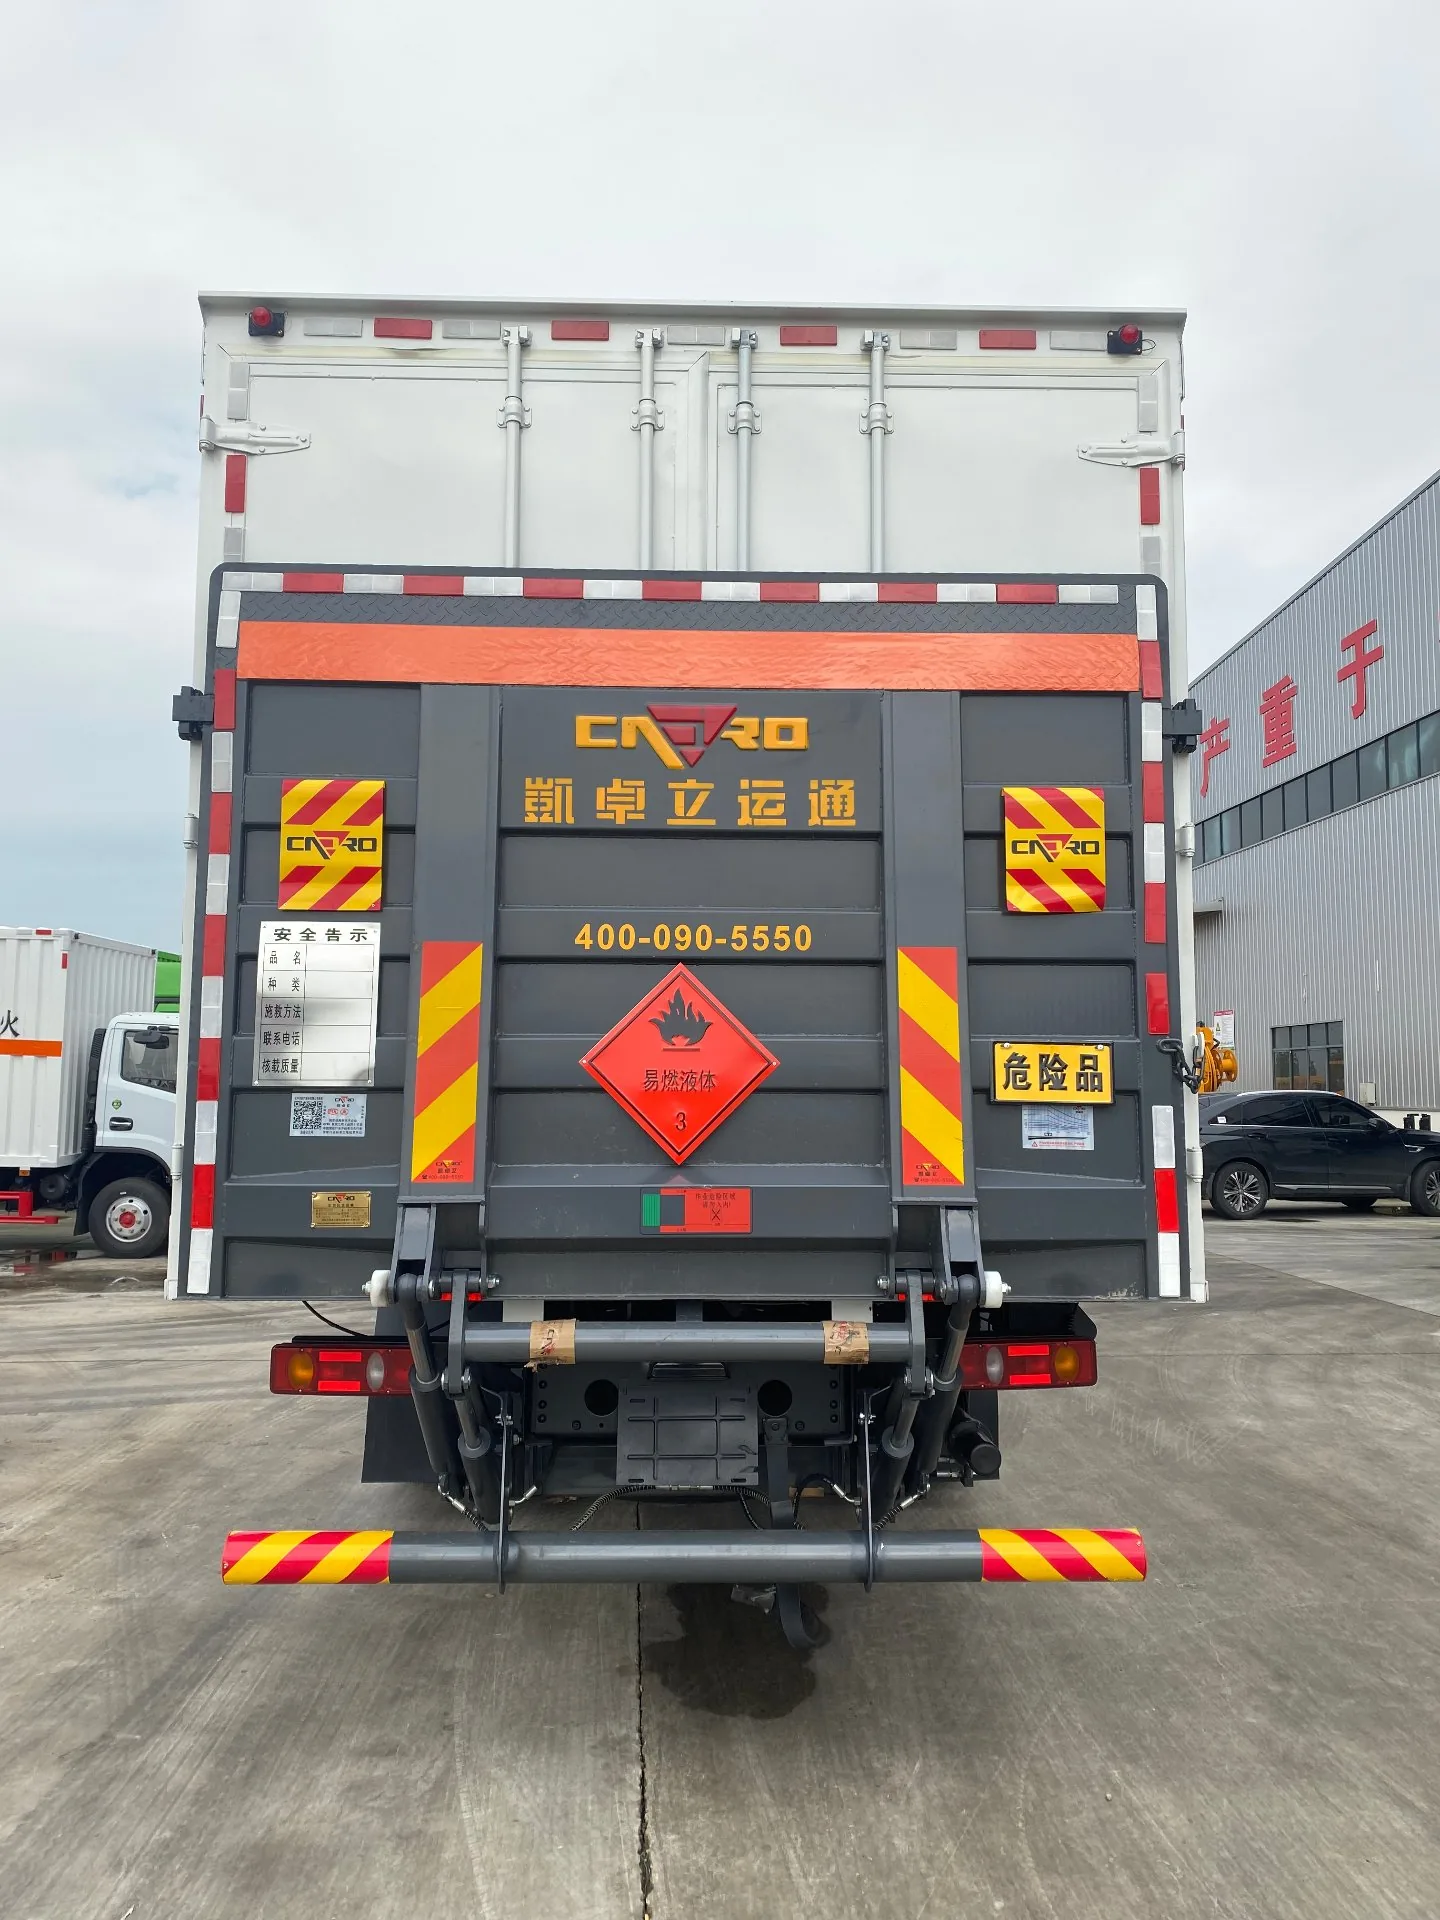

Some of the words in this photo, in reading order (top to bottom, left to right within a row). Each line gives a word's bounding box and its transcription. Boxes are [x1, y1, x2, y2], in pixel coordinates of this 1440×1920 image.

[273, 927, 368, 942] 安全告示
[574, 923, 812, 951] 400-090-5550
[264, 1003, 301, 1019] 施救方法
[263, 1031, 300, 1046] 联系电话
[261, 1058, 299, 1073] 核载质量
[1002, 1052, 1104, 1092] 危险品
[643, 1069, 716, 1092] 易燃液体
[675, 1112, 687, 1131] 3
